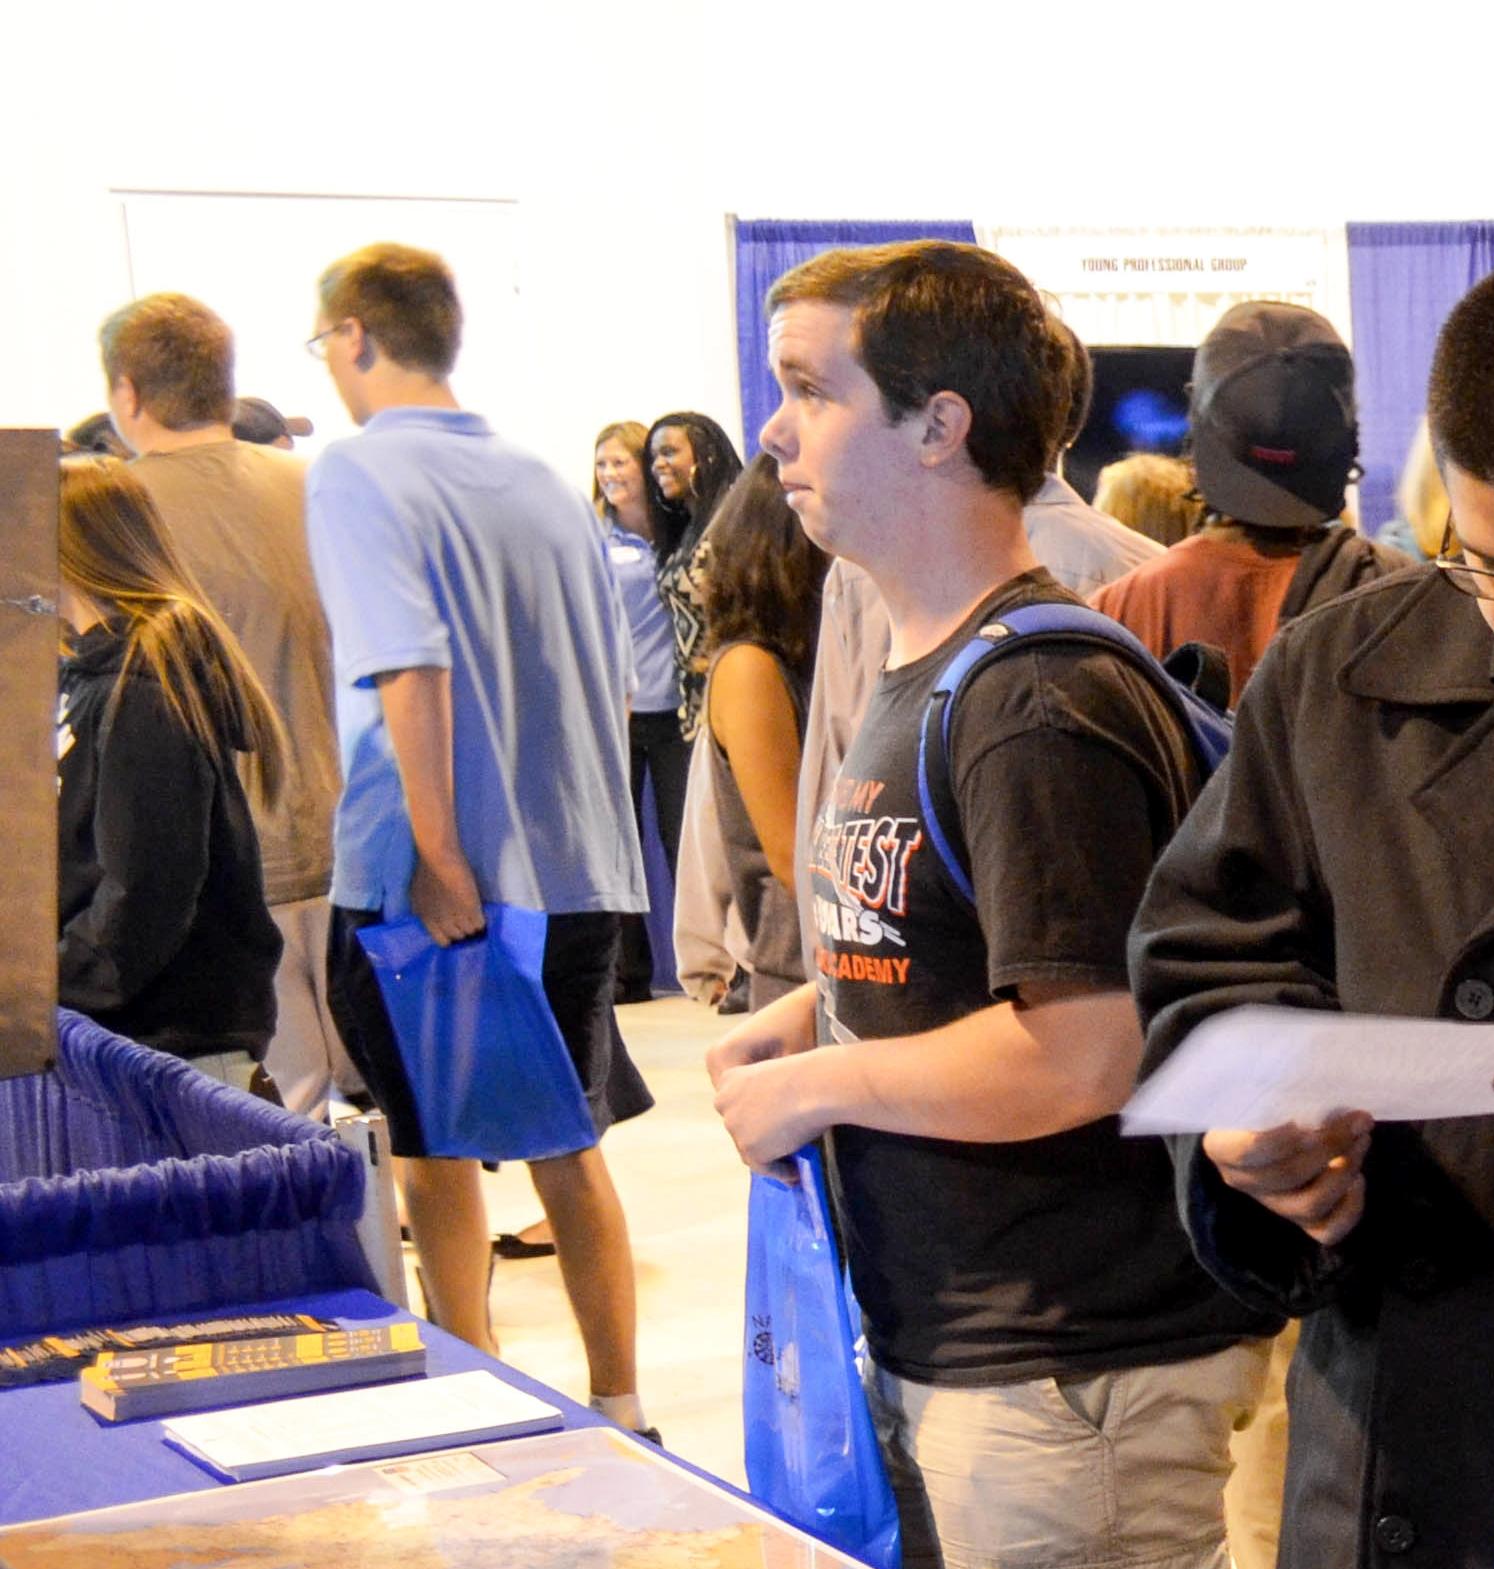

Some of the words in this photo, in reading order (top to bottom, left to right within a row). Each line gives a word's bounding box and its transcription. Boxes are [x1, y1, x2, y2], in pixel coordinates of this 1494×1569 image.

[1082, 257, 1118, 272] YOUNG
[1123, 257, 1204, 272] PROFESSIONAL
[1210, 257, 1248, 272] GROUP
